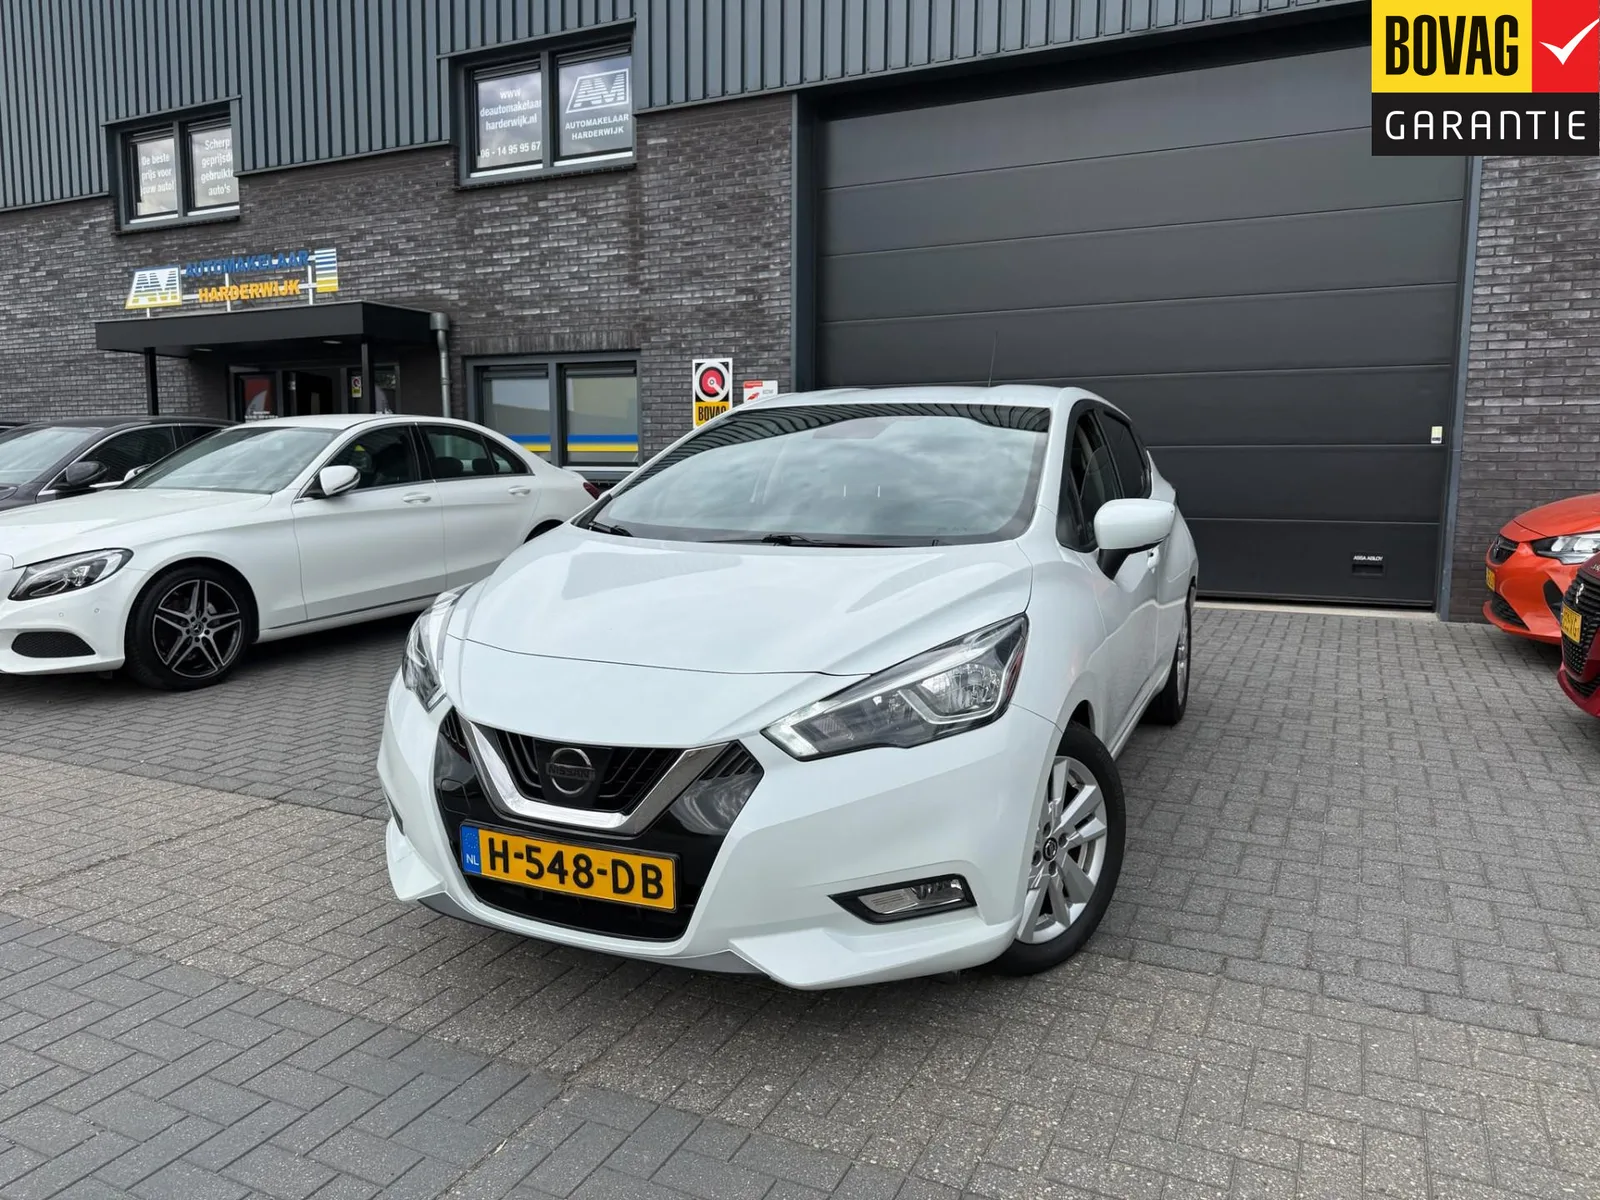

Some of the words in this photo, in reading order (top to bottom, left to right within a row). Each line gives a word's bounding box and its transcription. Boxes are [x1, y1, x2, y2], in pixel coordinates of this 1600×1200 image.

[499, 88, 521, 99] www
[485, 113, 537, 131] harderwijk.nl
[565, 114, 629, 130] AUTOMAKELAAR
[571, 126, 624, 140] HARDERWIJK
[204, 138, 231, 150] Scherp
[480, 148, 490, 159] 06
[498, 146, 506, 156] 14
[508, 144, 518, 154] 95
[519, 142, 529, 153] 95
[531, 141, 541, 151] 67
[141, 156, 150, 166] De
[151, 153, 170, 165] beste
[141, 170, 156, 182] prijs
[158, 168, 172, 178] voor
[208, 184, 231, 196] auto's
[185, 250, 309, 278] AUTOMAKELAAR
[198, 279, 301, 303] HARDERWIJK
[548, 763, 589, 778] NISSAN
[465, 853, 480, 867] NL
[488, 837, 665, 901] H-548-DB
